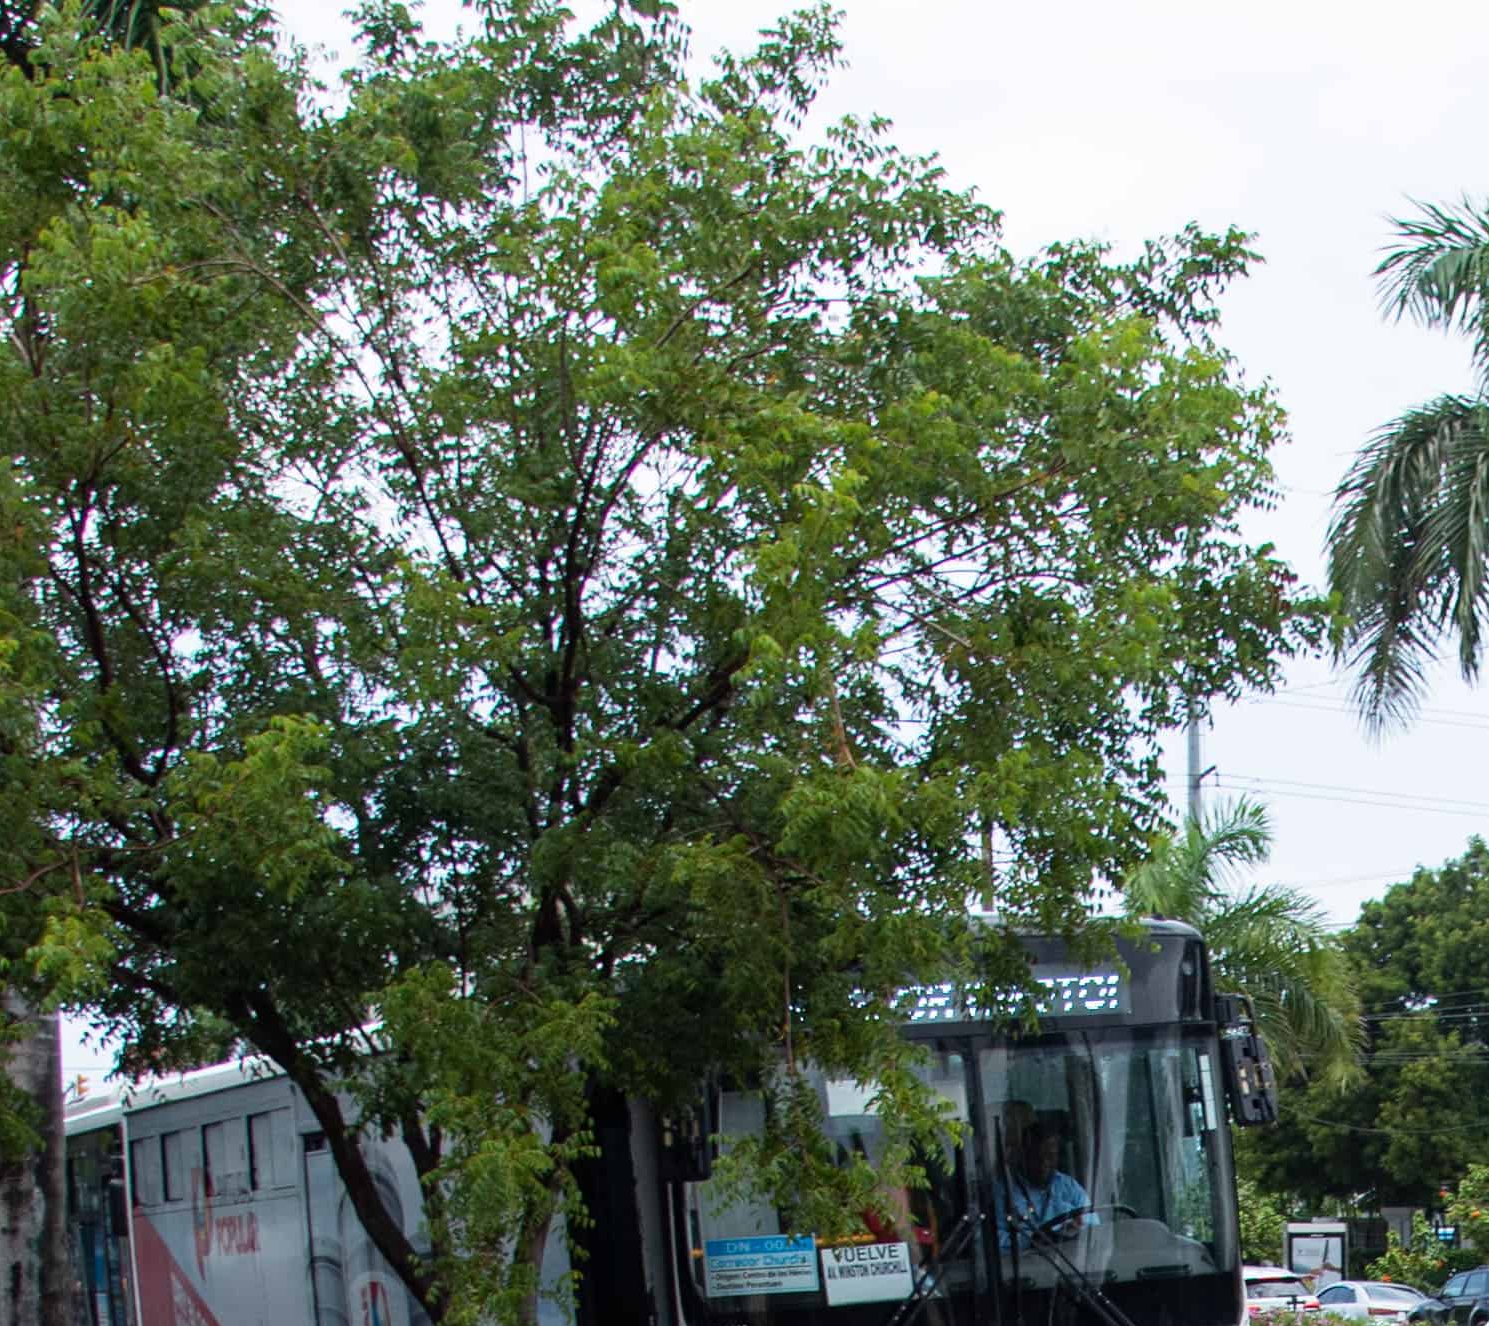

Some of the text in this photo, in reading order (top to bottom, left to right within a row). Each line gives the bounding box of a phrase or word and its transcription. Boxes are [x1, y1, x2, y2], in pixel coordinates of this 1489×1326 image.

[831, 1245, 900, 1263] VUELVE
[838, 1263, 869, 1279] WINSTON
[870, 1260, 908, 1276] CHURCHILL
